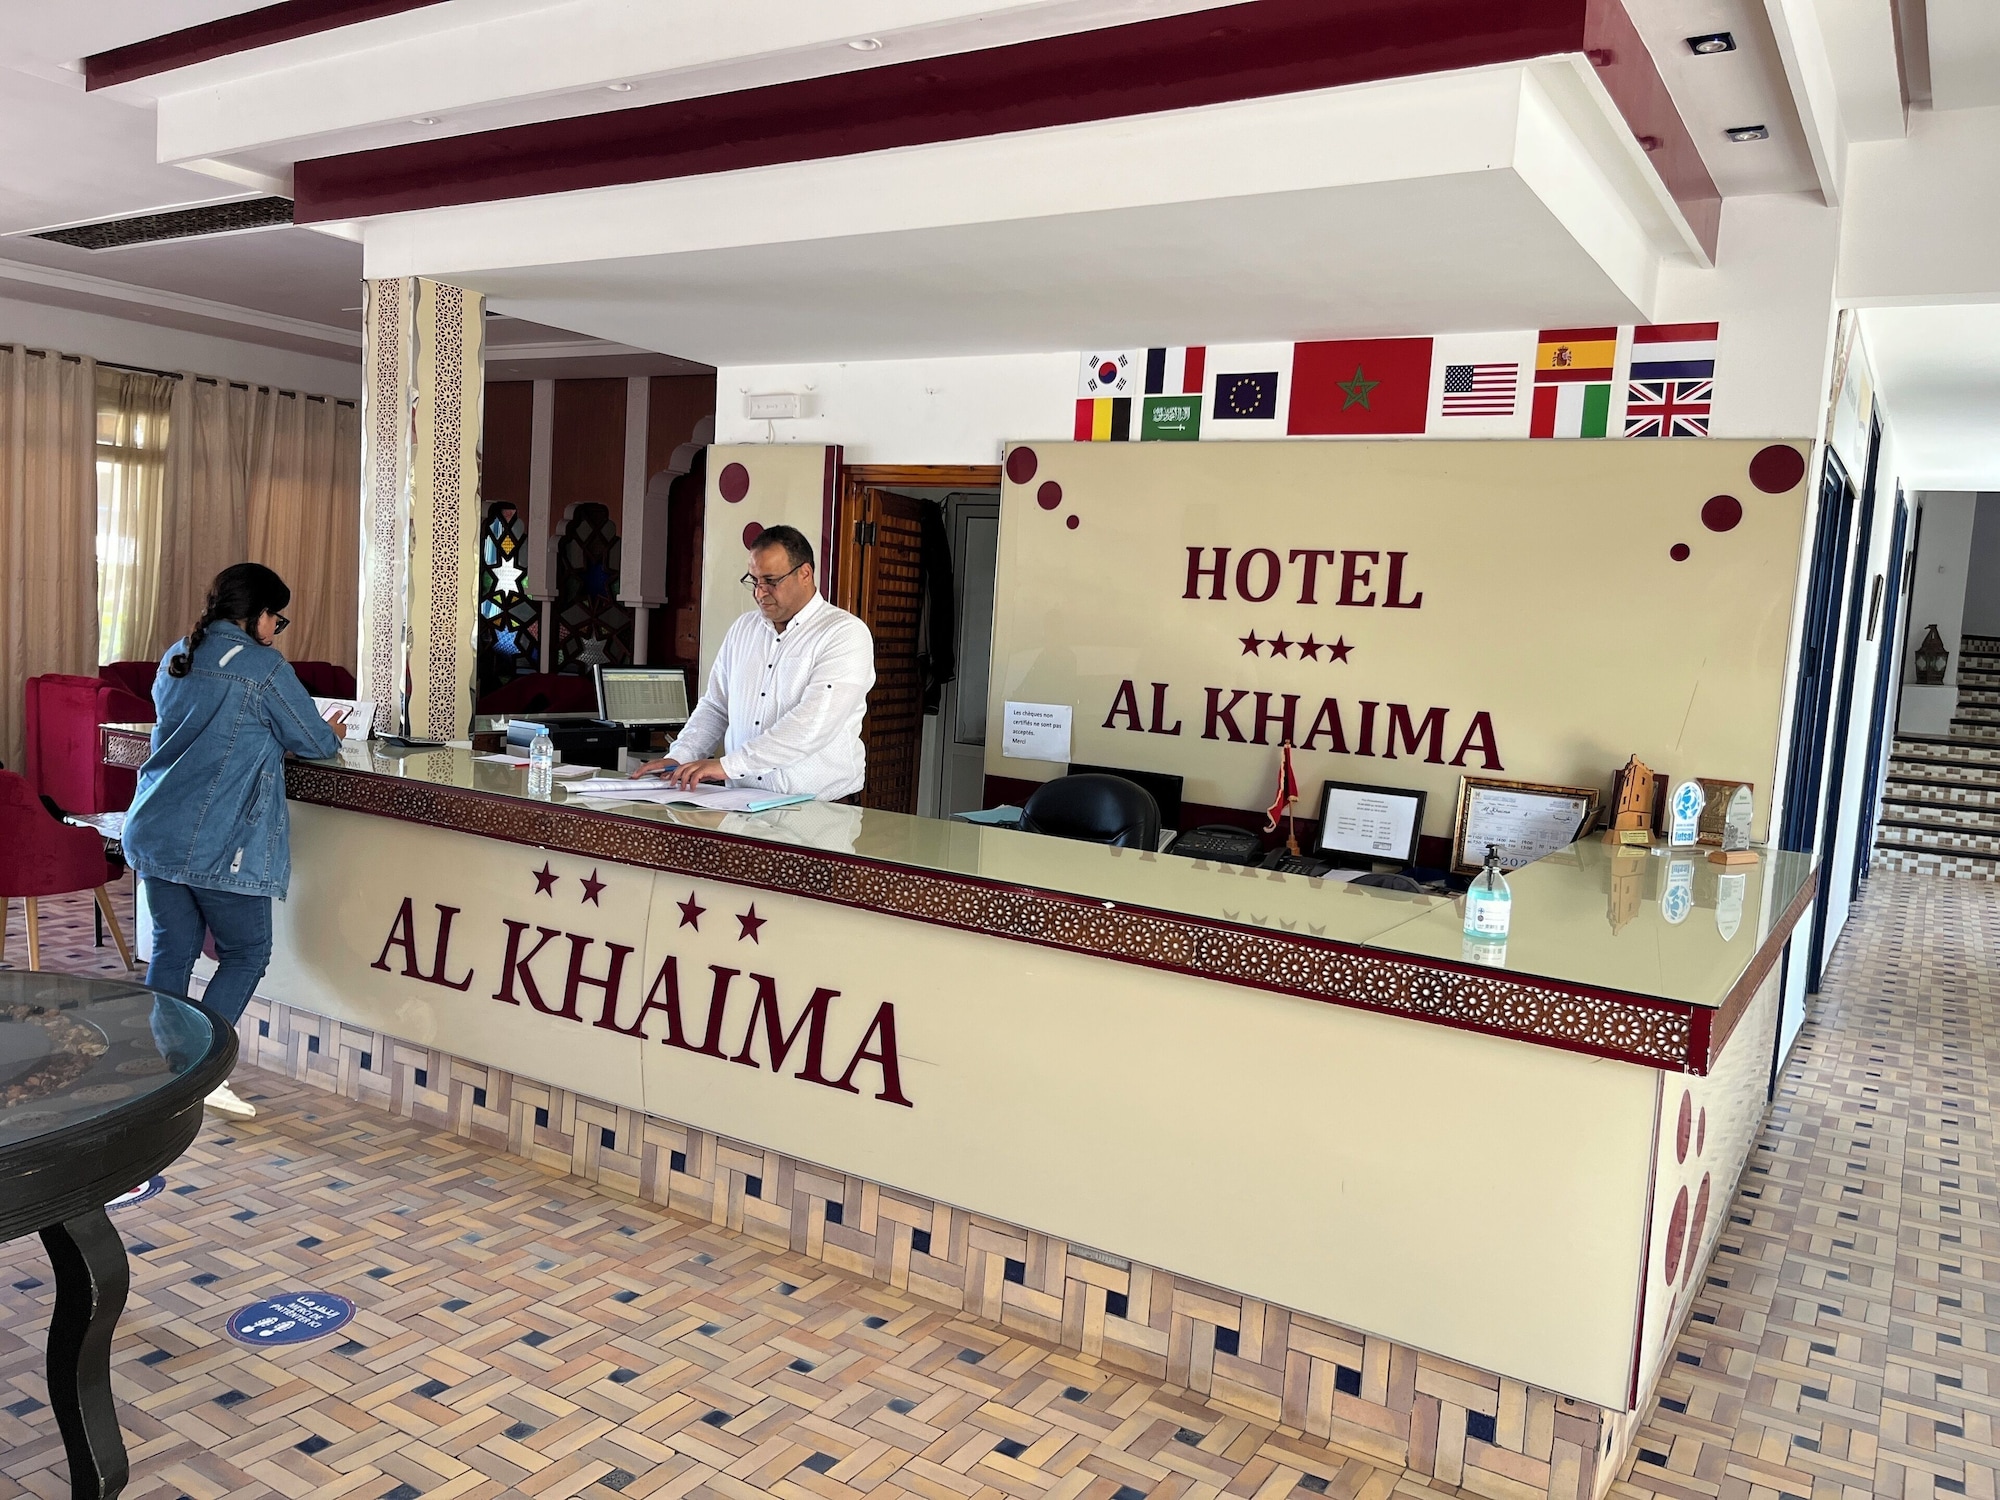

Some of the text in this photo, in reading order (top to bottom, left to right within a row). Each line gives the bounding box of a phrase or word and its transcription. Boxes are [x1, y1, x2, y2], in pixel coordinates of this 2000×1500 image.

[1182, 546, 1423, 609] HOTEL
[1022, 710, 1042, 718] chèques
[1102, 680, 1504, 771] AL KHAIMA
[1501, 856, 1528, 867] 202
[371, 897, 913, 1108] AL KHAIMA
[269, 1303, 322, 1328] PATIENTER ICI
[287, 1303, 324, 1321] MERCI DE
